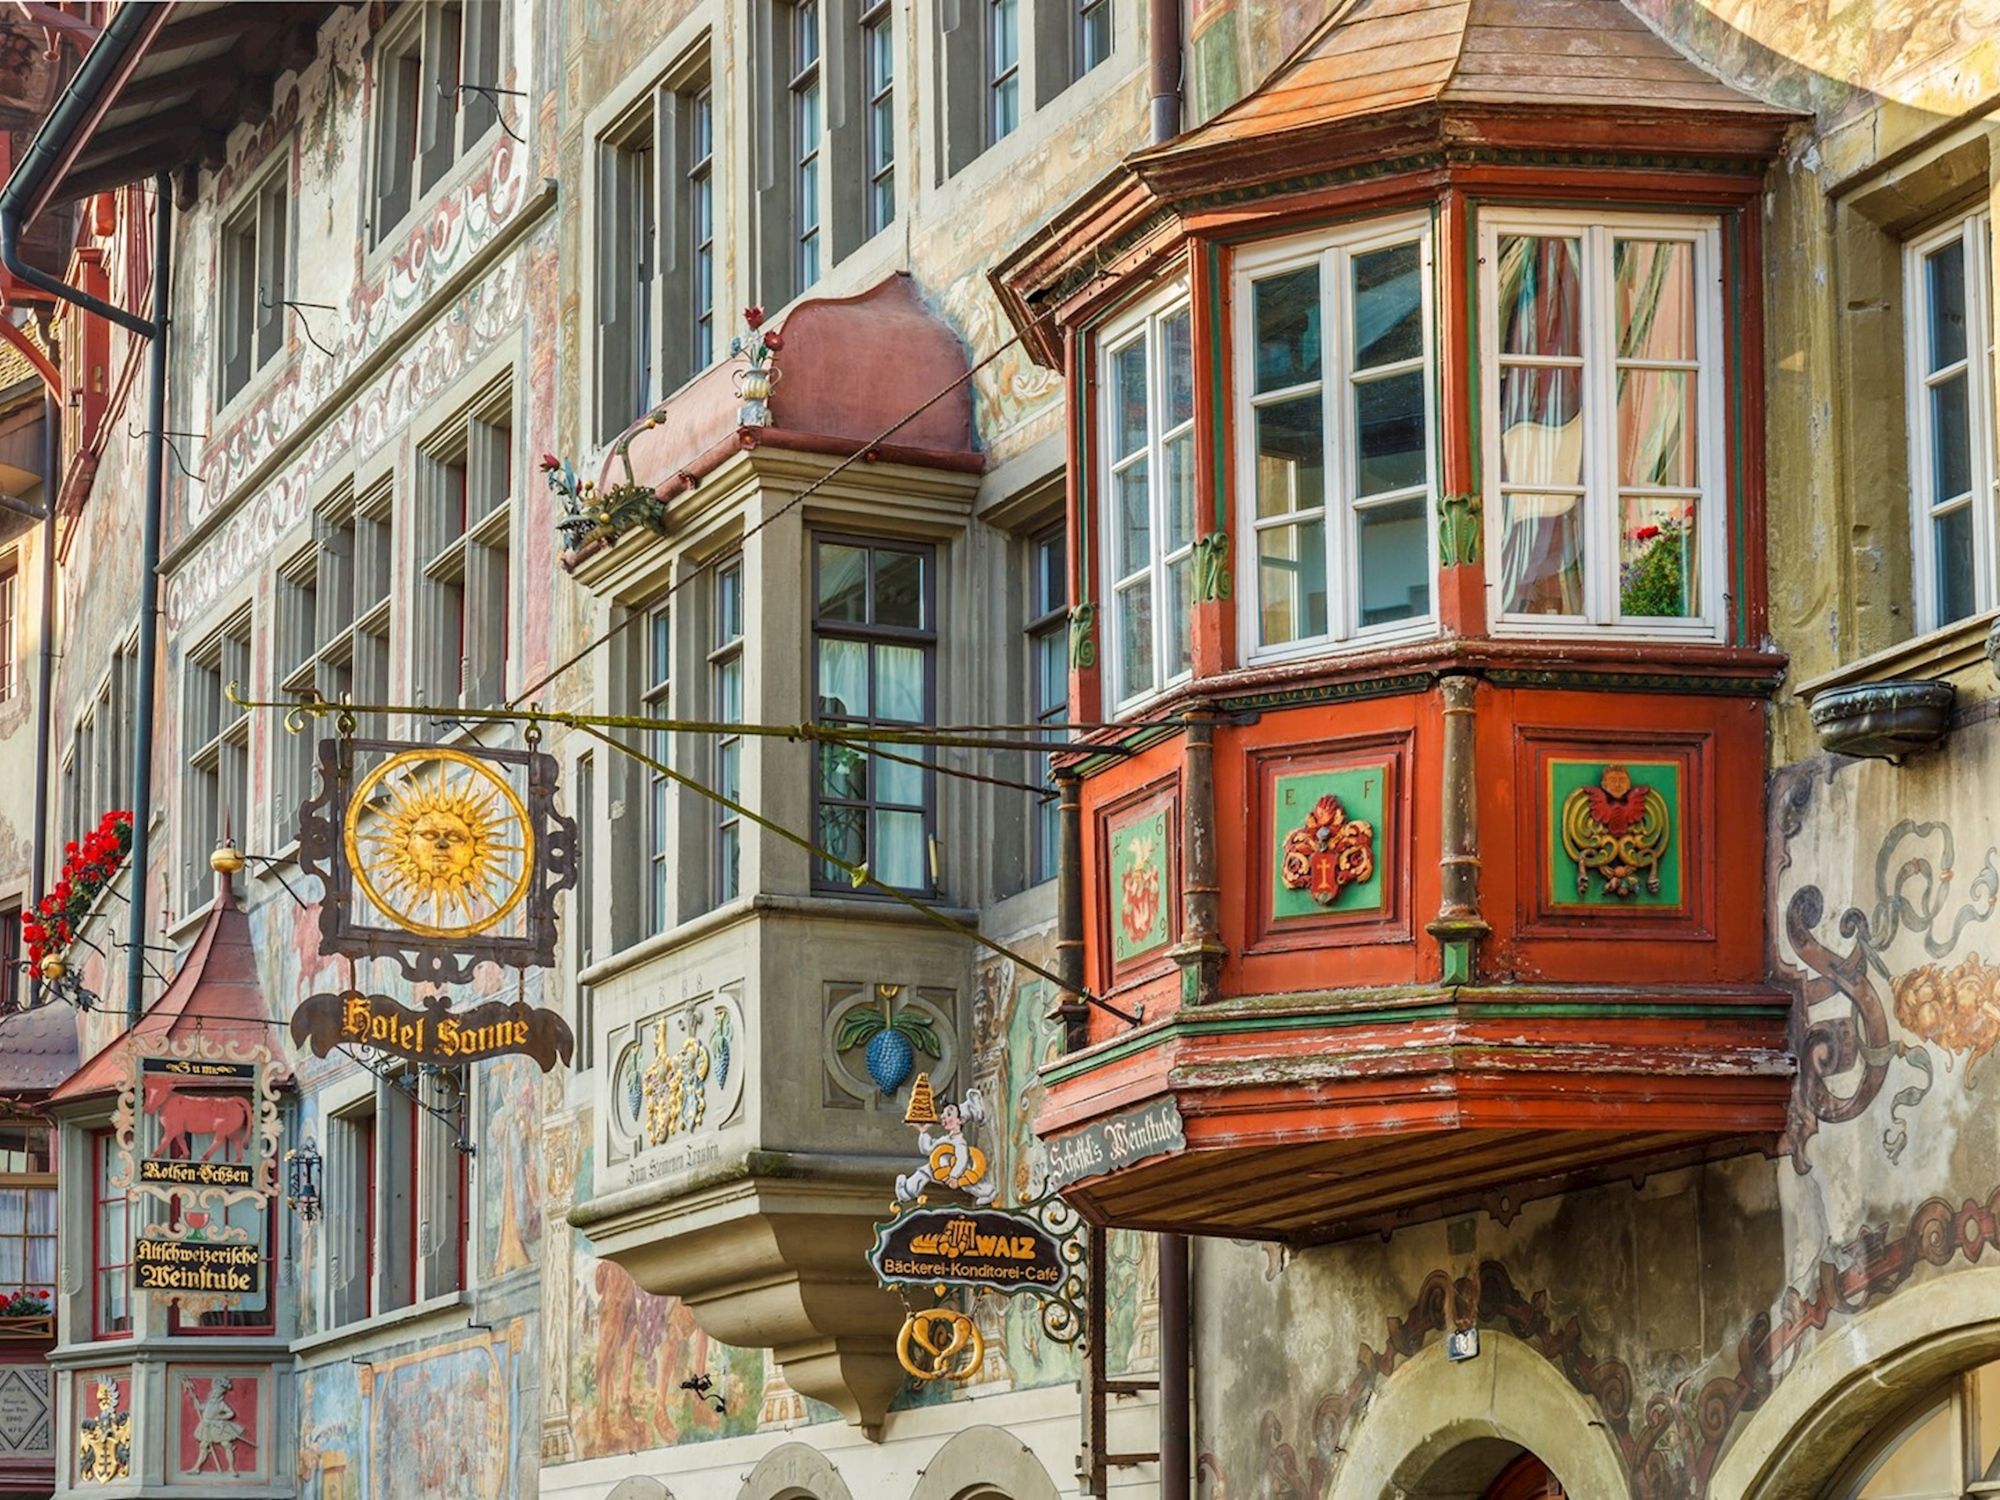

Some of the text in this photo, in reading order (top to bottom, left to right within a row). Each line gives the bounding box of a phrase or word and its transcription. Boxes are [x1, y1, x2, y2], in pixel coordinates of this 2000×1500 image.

[341, 998, 529, 1057] Hotel Sonne
[1104, 1107, 1178, 1161] Weinstube
[976, 1234, 1036, 1260] WALZ
[141, 1264, 251, 1290] Weinstube
